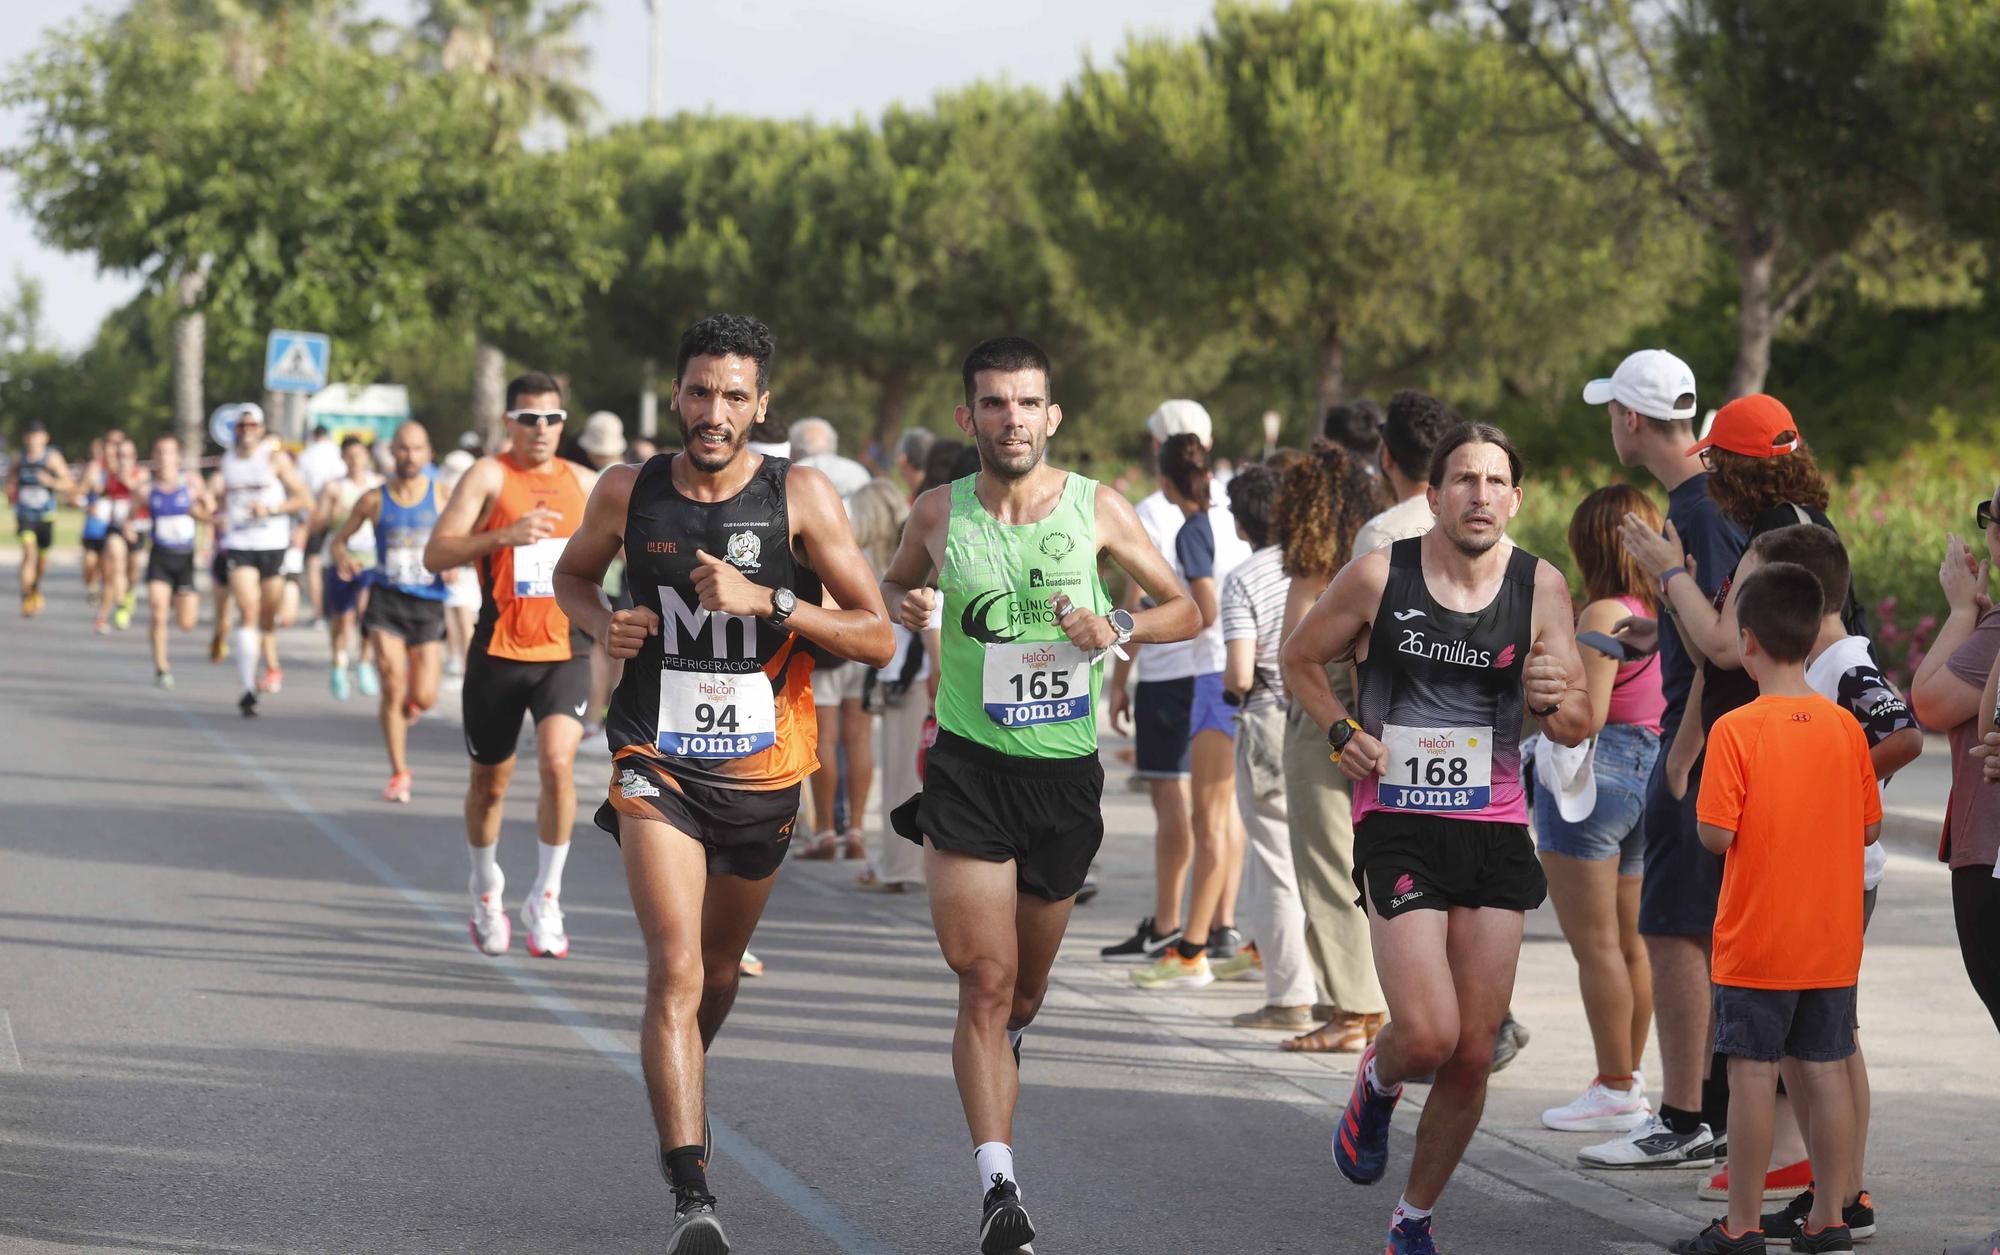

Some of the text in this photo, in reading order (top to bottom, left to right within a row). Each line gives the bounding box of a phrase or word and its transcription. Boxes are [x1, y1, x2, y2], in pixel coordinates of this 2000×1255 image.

[1045, 577, 1082, 587] Guadalajara
[1009, 598, 1053, 612] CLÍNIC
[1010, 611, 1057, 626] MENO
[1398, 629, 1491, 668] 26 millas
[1009, 670, 1069, 702] 165
[695, 703, 739, 733] 94
[1405, 757, 1468, 786] 168
